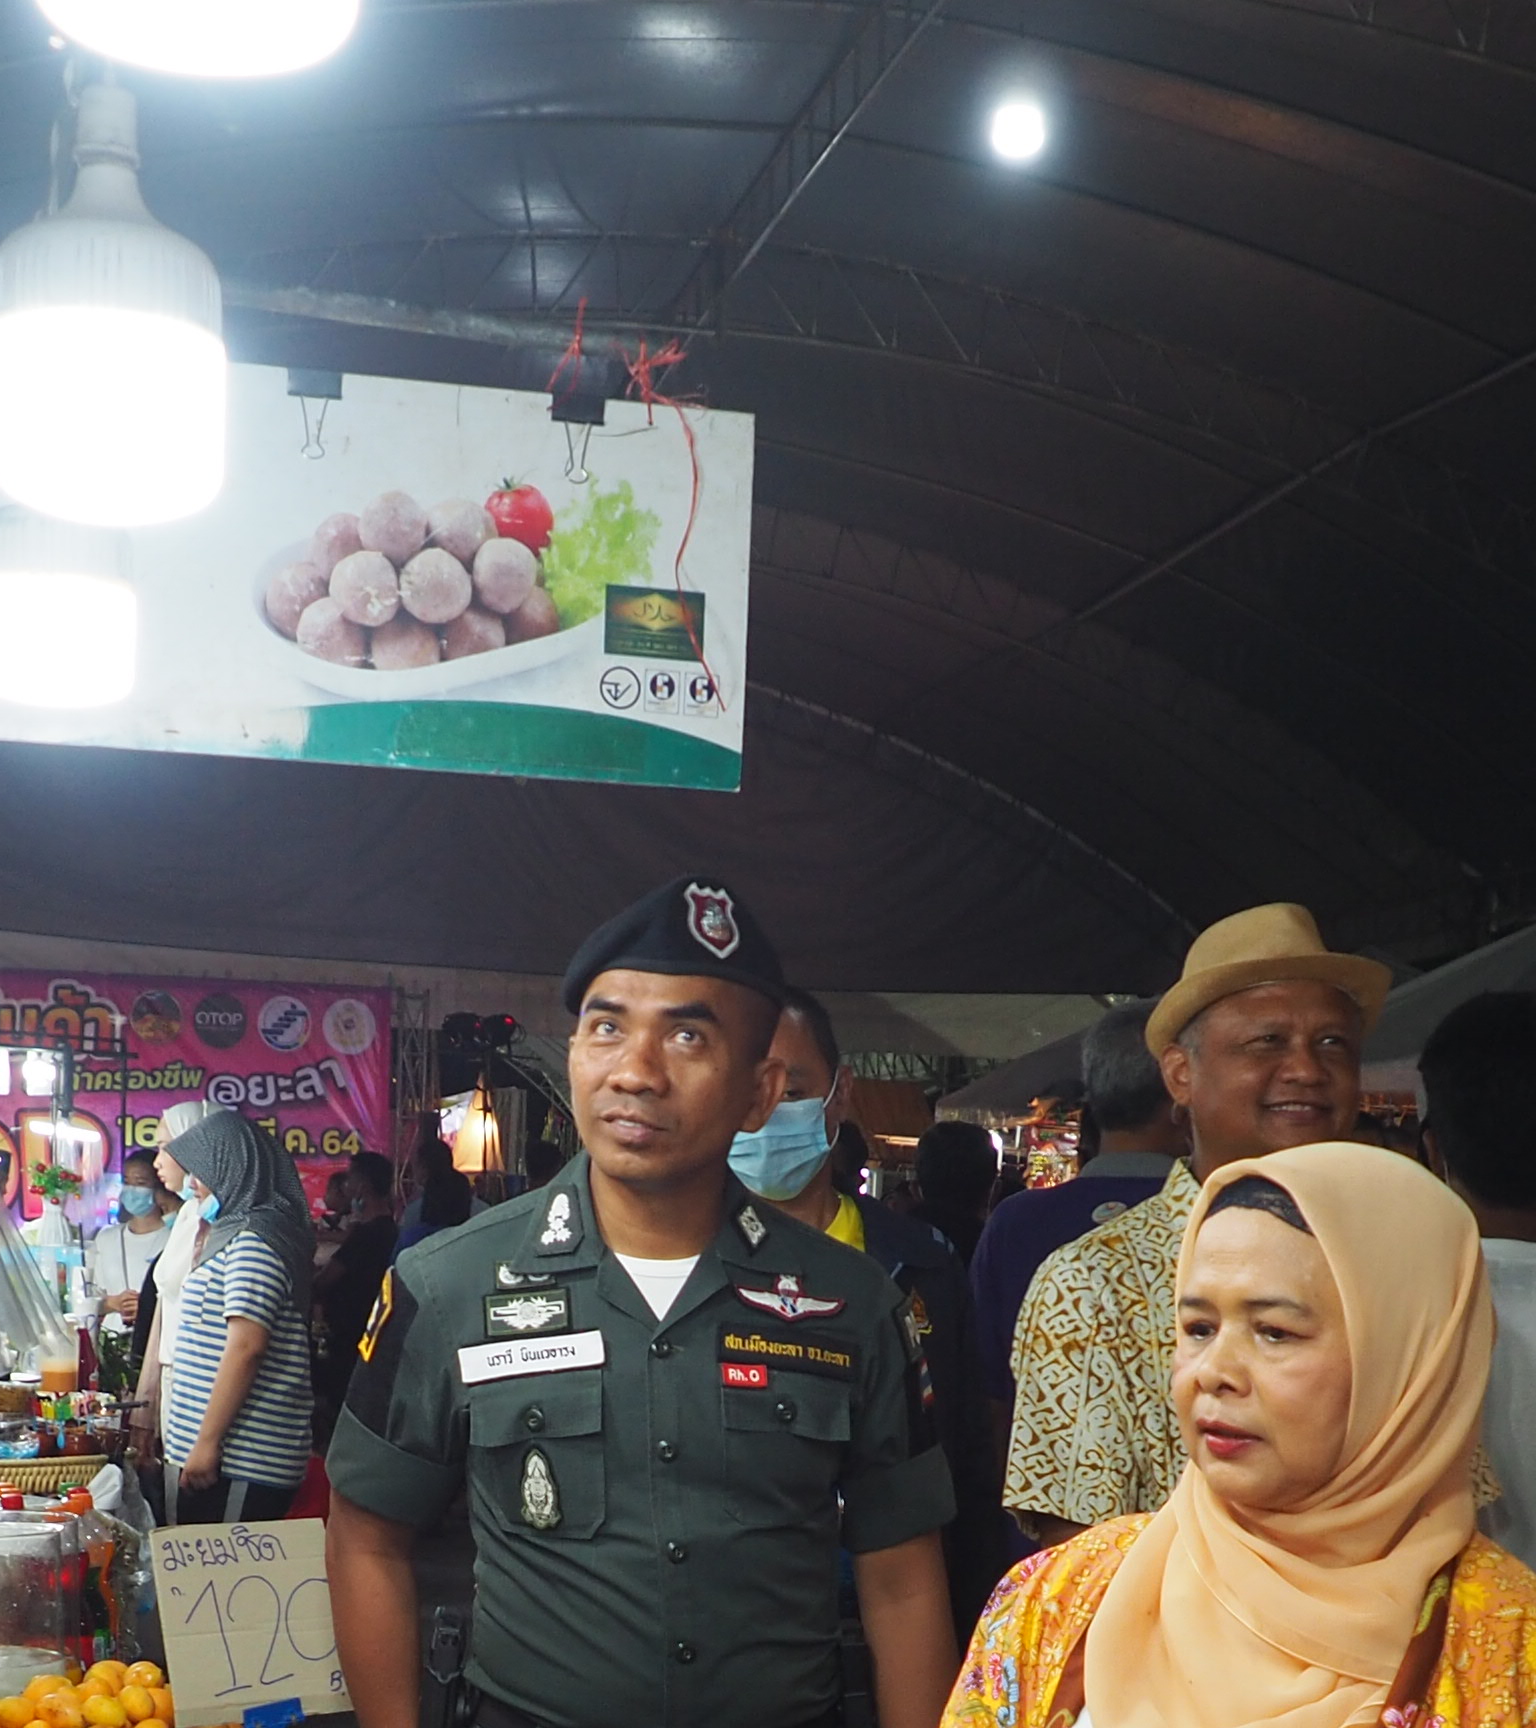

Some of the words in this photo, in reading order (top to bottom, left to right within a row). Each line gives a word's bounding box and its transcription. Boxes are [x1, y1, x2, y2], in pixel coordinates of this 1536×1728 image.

[195, 1011, 243, 1026] OTOP
[322, 1128, 361, 1155] 64
[185, 1575, 336, 1697] 120
